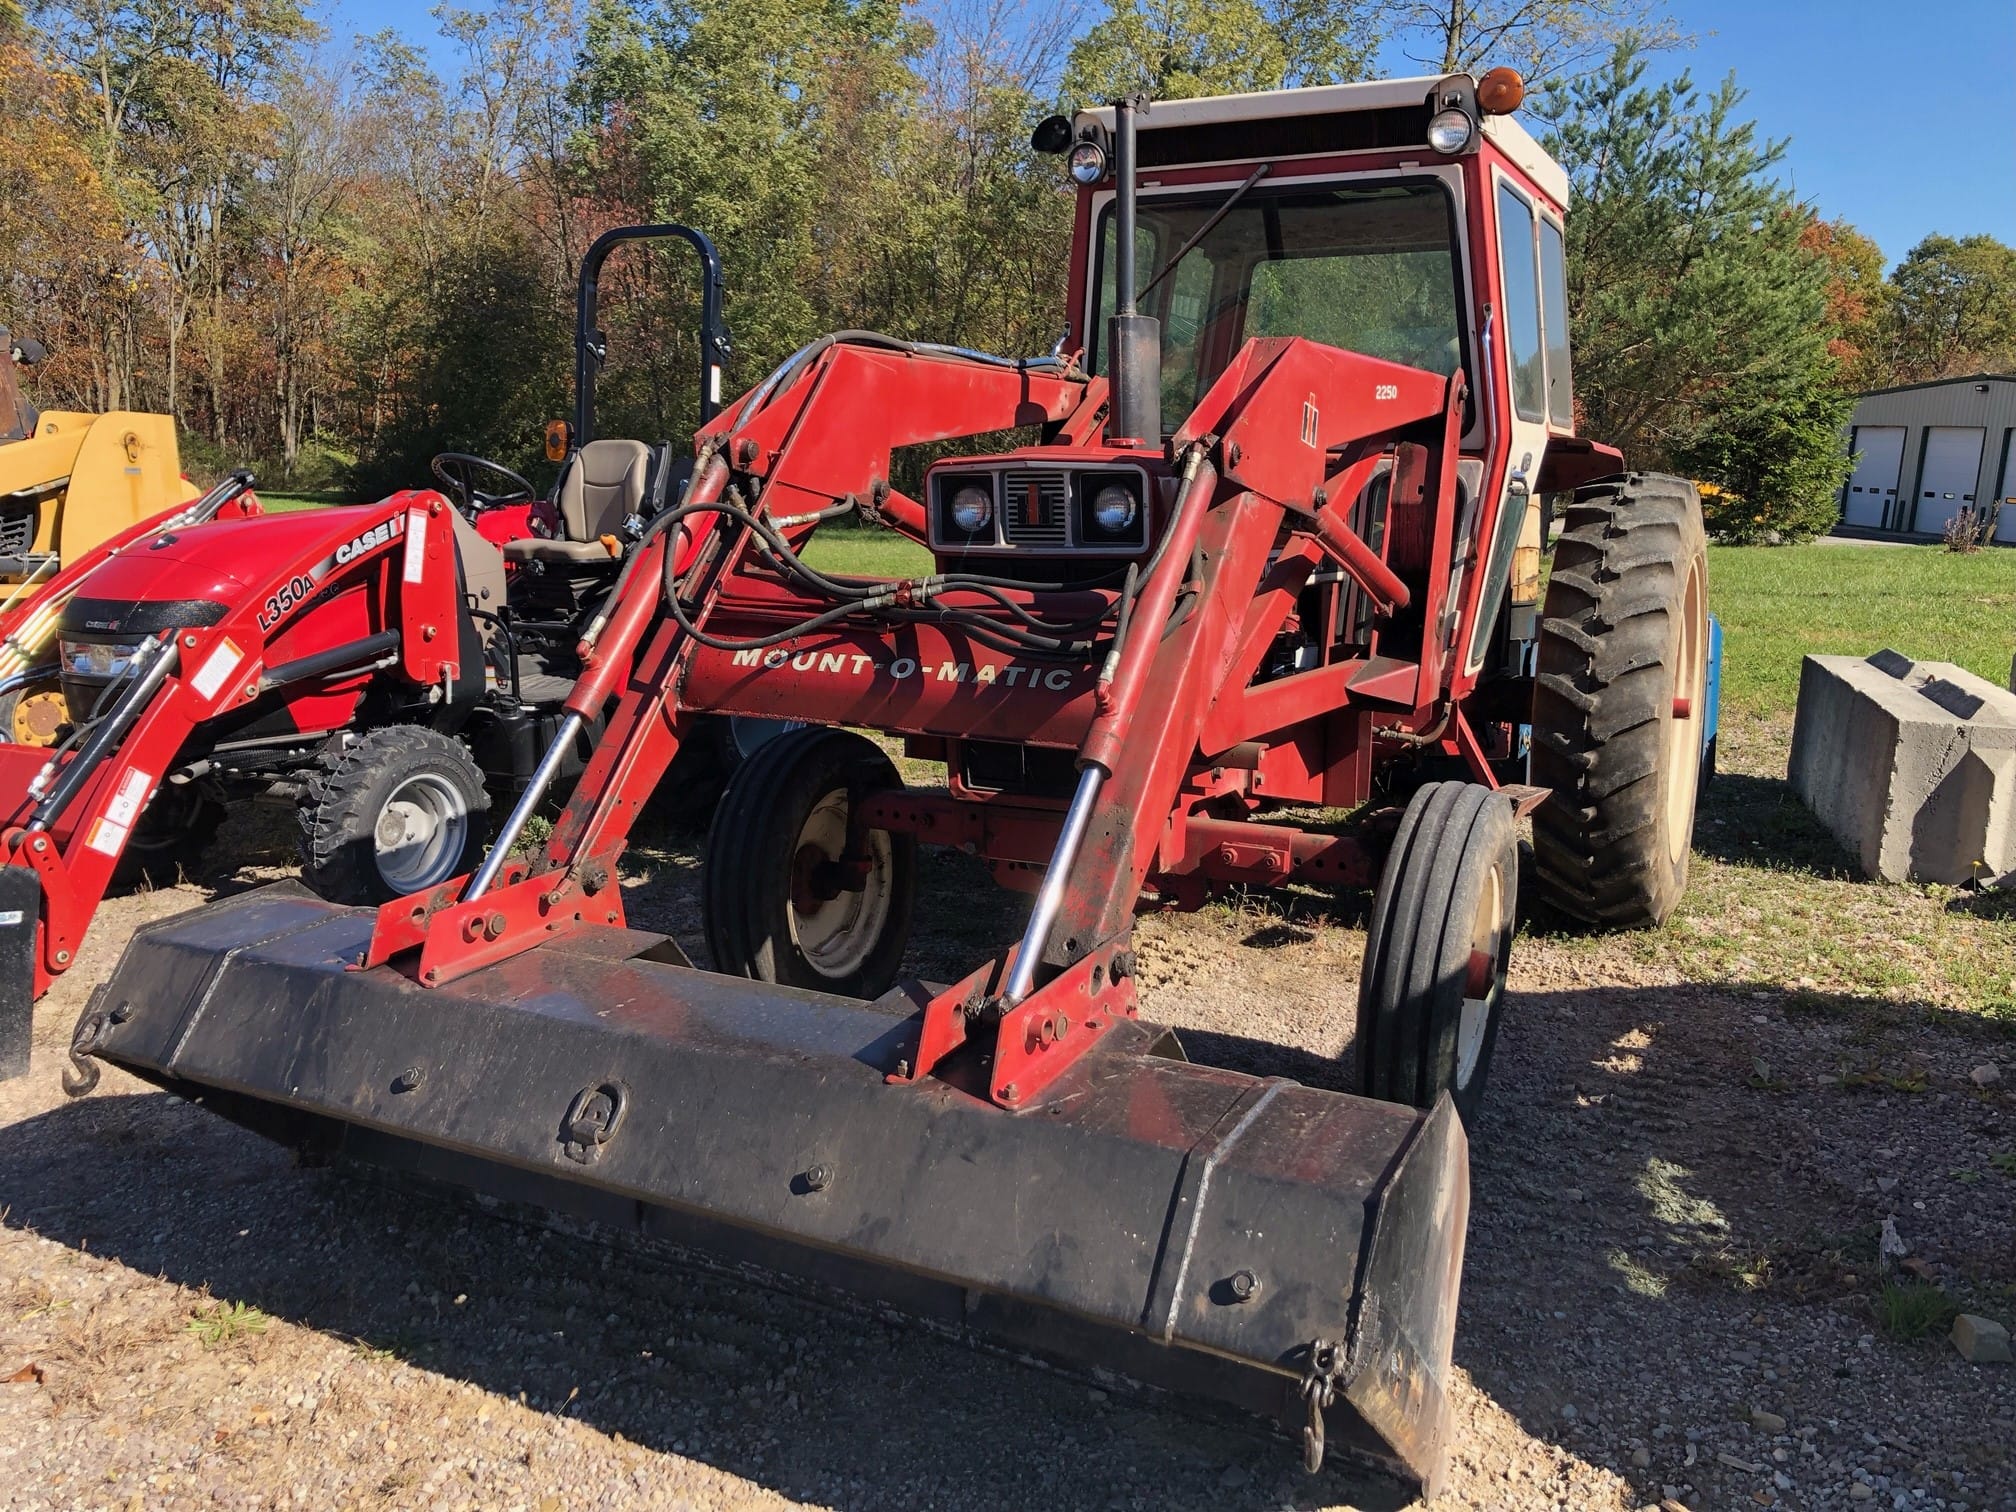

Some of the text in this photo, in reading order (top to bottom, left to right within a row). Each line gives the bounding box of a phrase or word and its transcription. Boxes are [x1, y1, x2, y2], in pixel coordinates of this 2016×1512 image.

[1376, 385, 1398, 400] 2250
[335, 527, 391, 564] CASE
[256, 575, 315, 633] L350A
[731, 648, 1073, 691] MOUNT-O-MATIC
